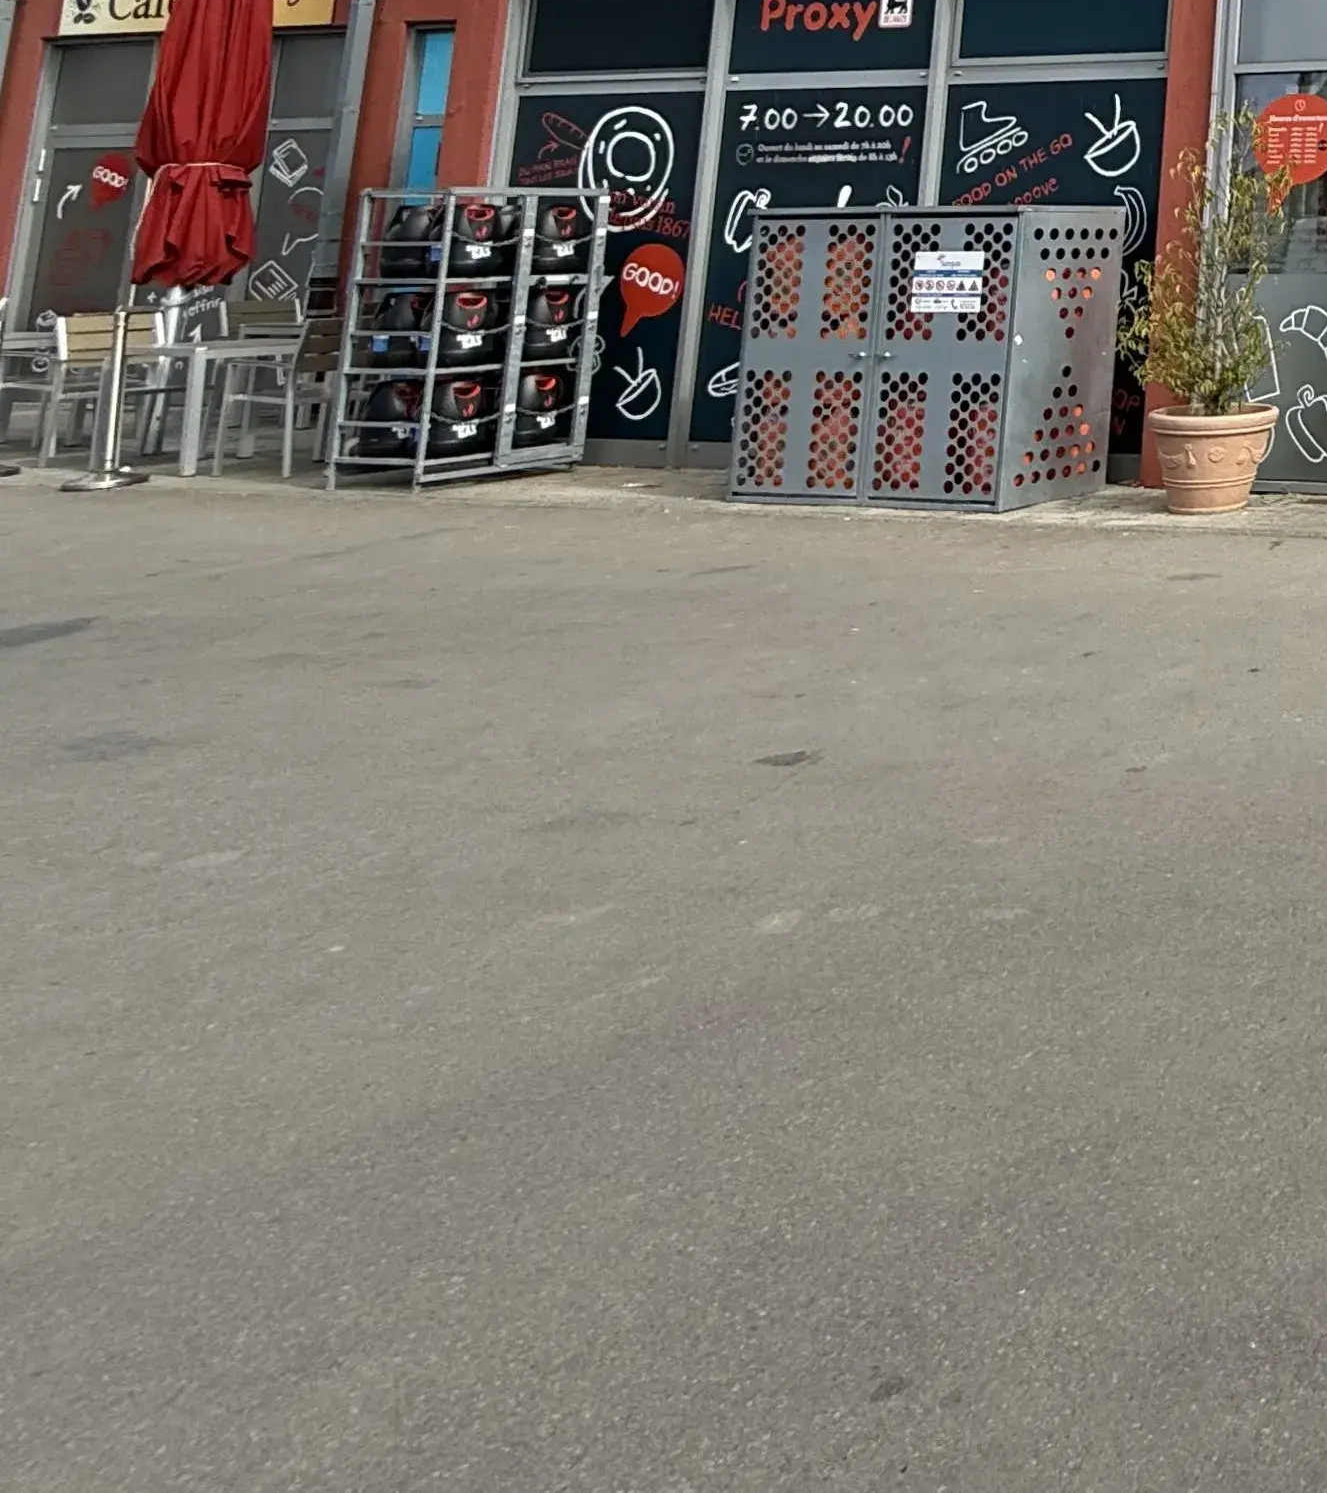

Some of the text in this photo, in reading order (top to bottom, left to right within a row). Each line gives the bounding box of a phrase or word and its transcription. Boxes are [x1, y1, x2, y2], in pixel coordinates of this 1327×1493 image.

[739, 102, 914, 131] 7.00 20.00
[995, 166, 1018, 187] ON
[1019, 148, 1047, 172] THE
[1050, 133, 1073, 155] GO
[92, 166, 129, 191] GOOD!
[623, 263, 680, 298] GOOD!
